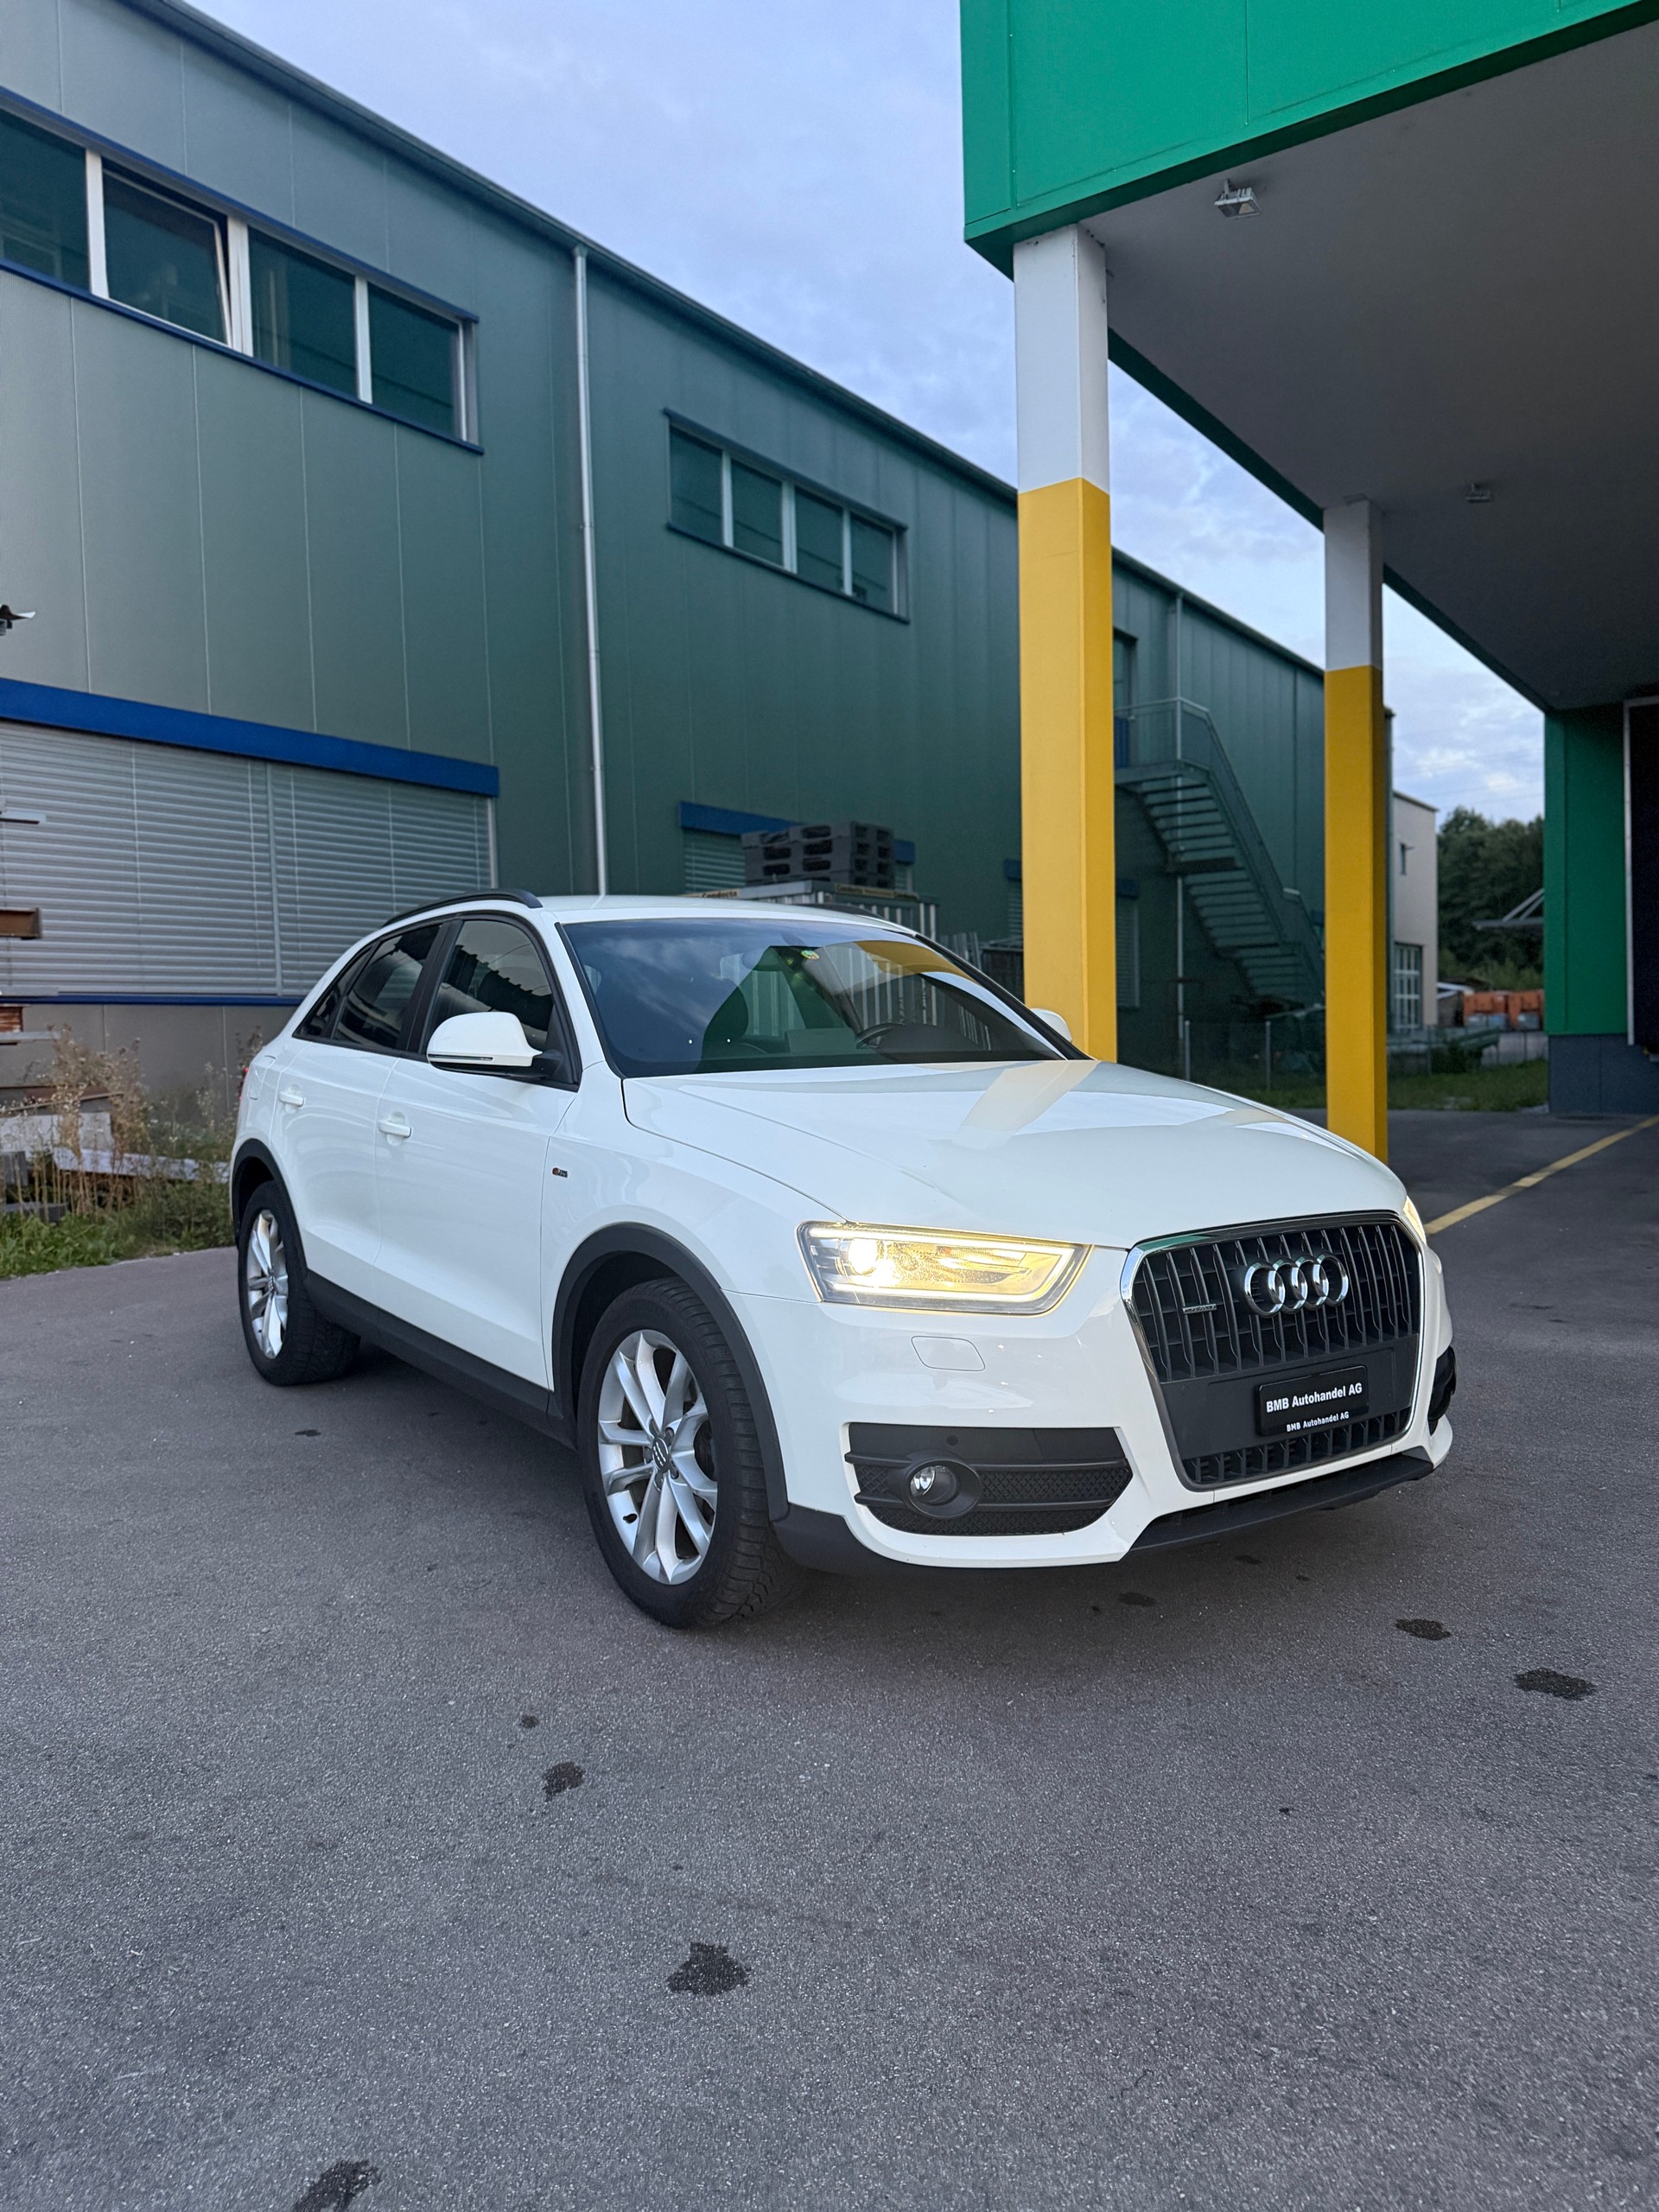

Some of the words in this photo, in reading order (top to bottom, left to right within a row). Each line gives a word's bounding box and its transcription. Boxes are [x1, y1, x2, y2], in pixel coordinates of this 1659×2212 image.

[1266, 1397, 1289, 1413] BMB
[1292, 1385, 1346, 1408] Autohandel
[1348, 1382, 1363, 1396] AG
[1287, 1422, 1300, 1432] BMB
[1302, 1413, 1339, 1429] Autohandel
[1340, 1411, 1350, 1421] AG
